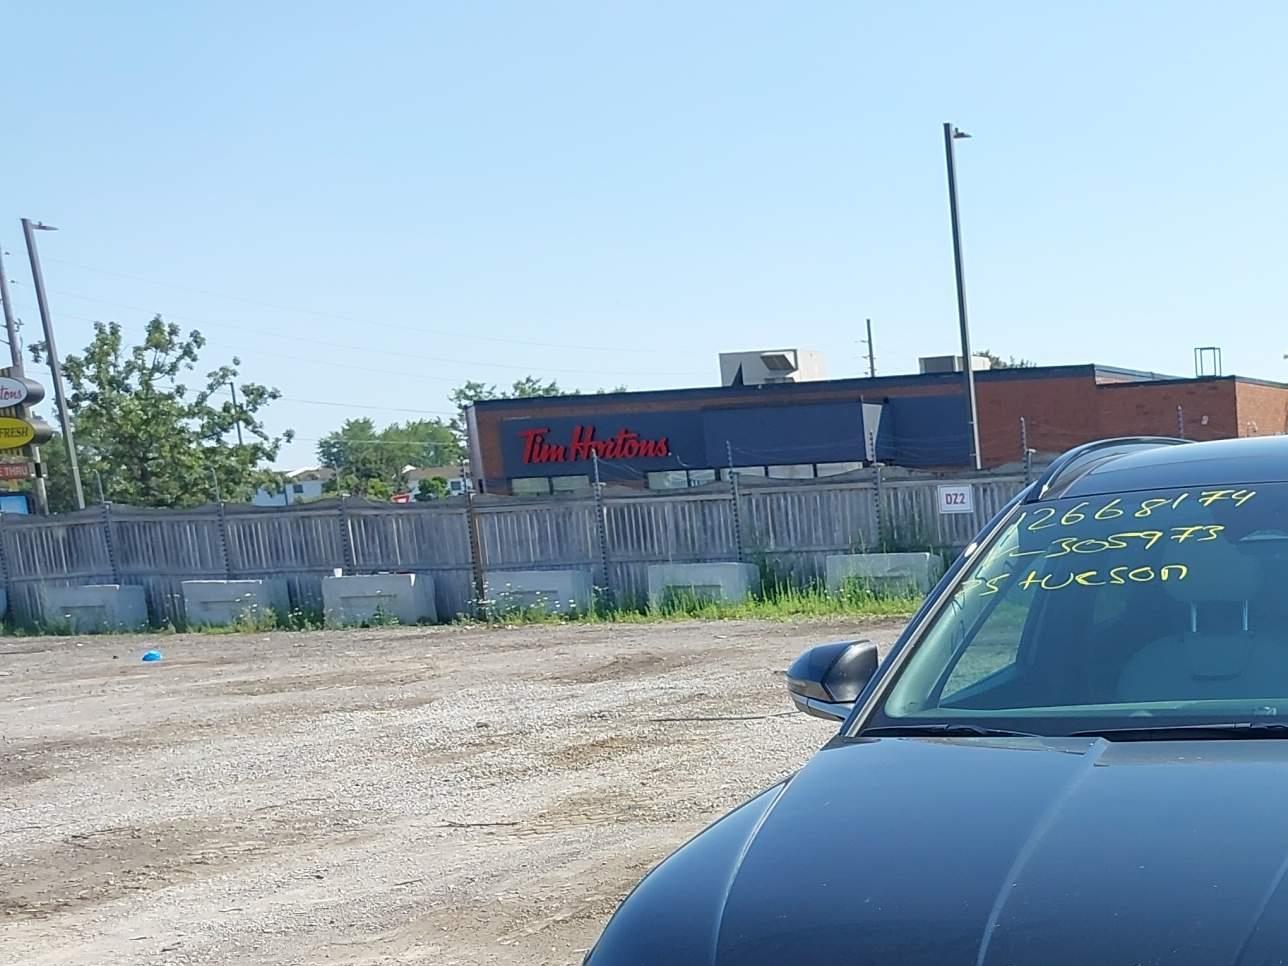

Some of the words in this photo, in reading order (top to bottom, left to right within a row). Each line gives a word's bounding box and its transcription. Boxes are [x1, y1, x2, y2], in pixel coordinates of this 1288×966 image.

[518, 427, 566, 464] Tim
[570, 425, 669, 461] Hortons
[945, 493, 966, 505] DZ2
[1009, 489, 1257, 532] 12668174
